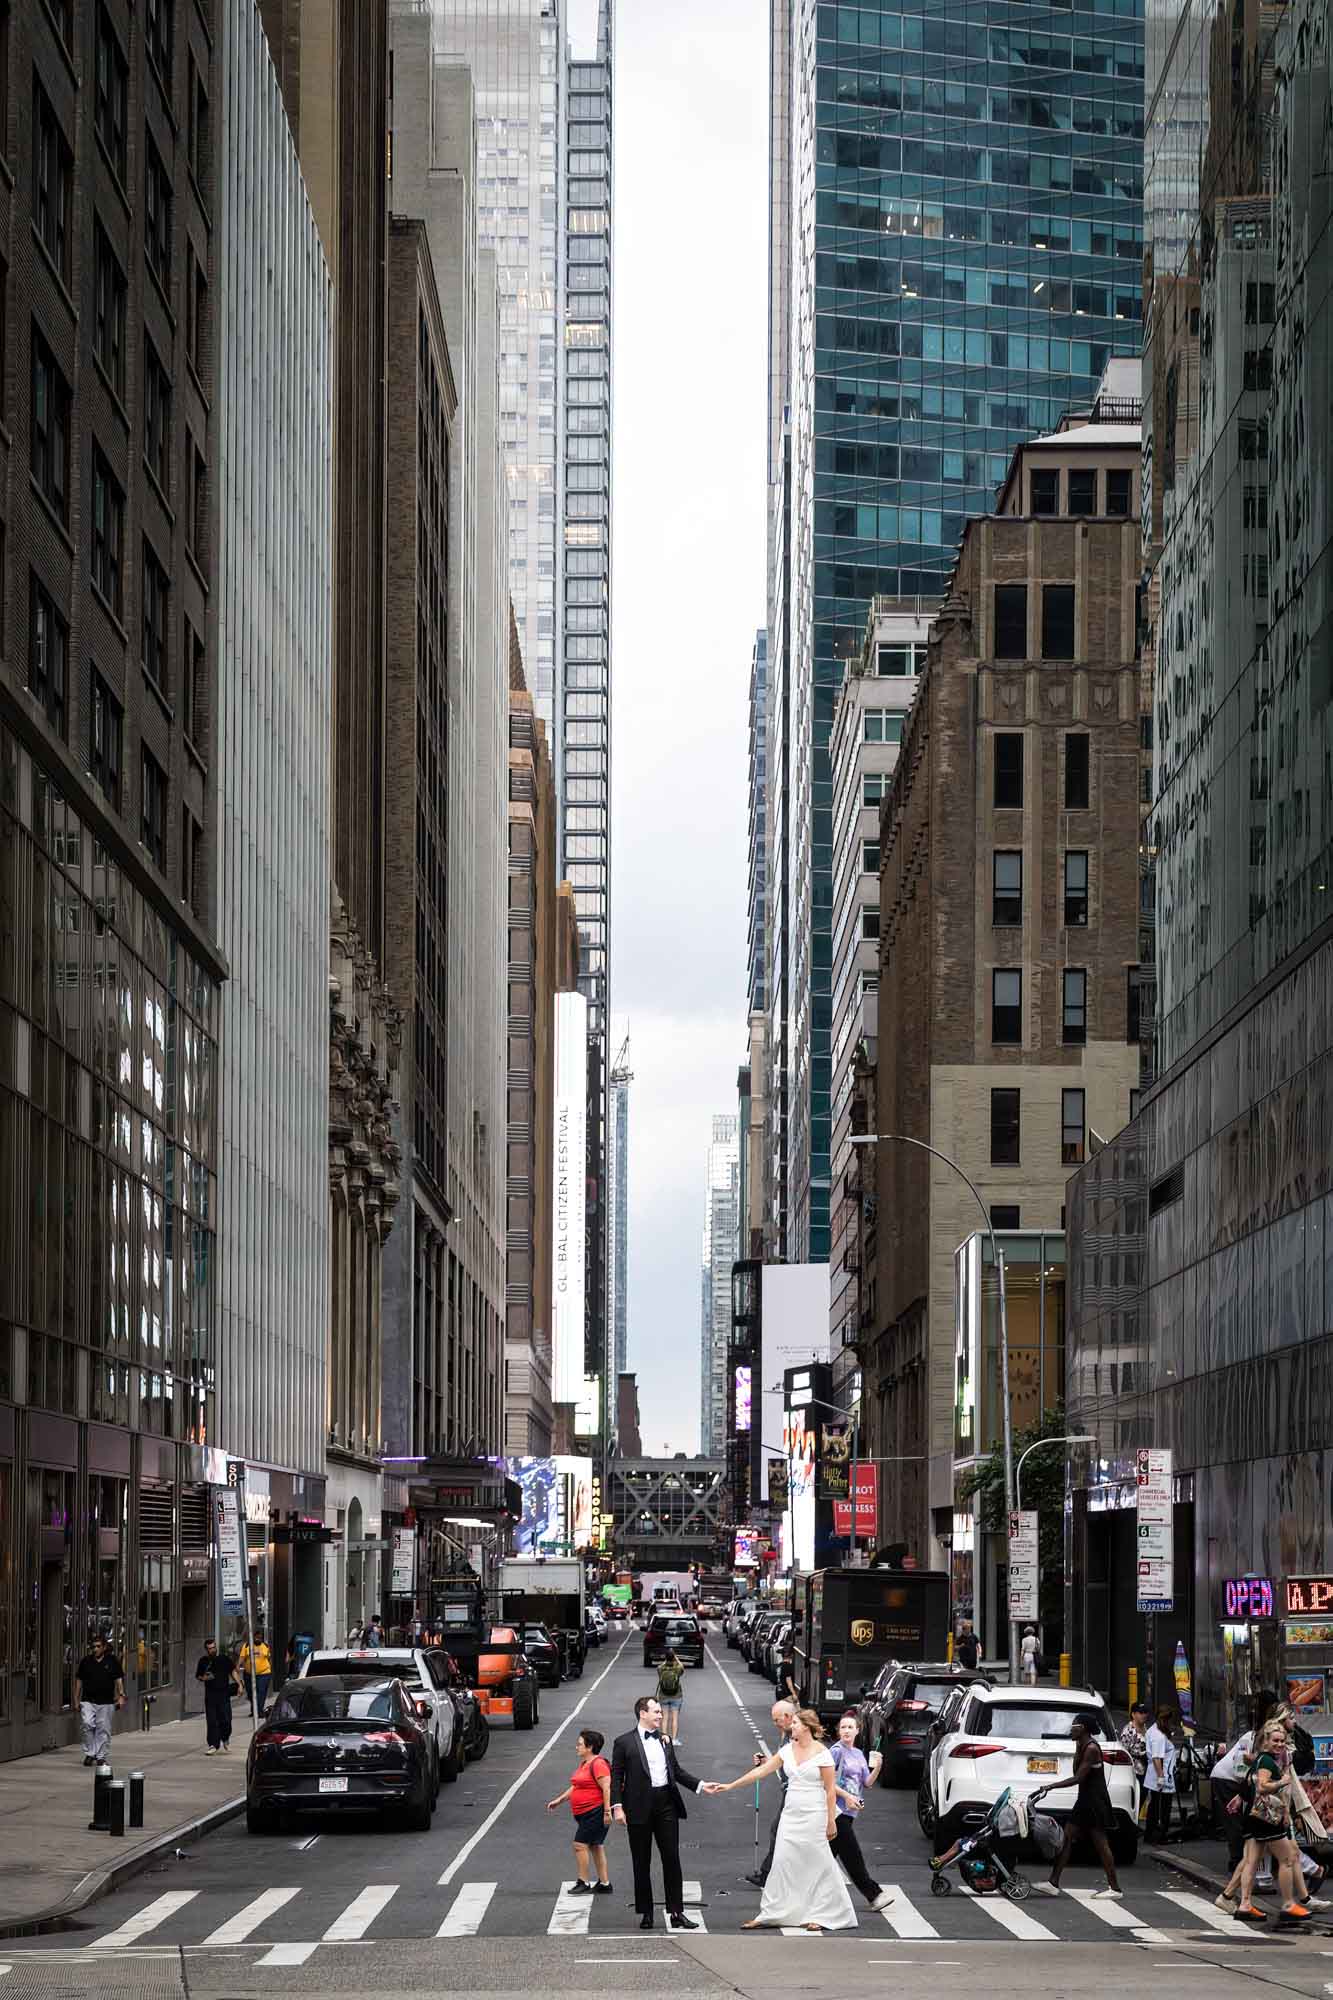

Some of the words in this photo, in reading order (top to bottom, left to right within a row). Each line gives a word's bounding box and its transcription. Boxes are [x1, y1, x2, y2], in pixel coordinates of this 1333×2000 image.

[558, 1104, 569, 1172] FESTIVAL
[558, 1175, 568, 1231] CITIZEN
[823, 1465, 842, 1482] Harry
[828, 1473, 848, 1489] Potter
[1141, 1527, 1147, 1536] 6
[1226, 1580, 1273, 1616] OPEN
[853, 1627, 872, 1641] ups
